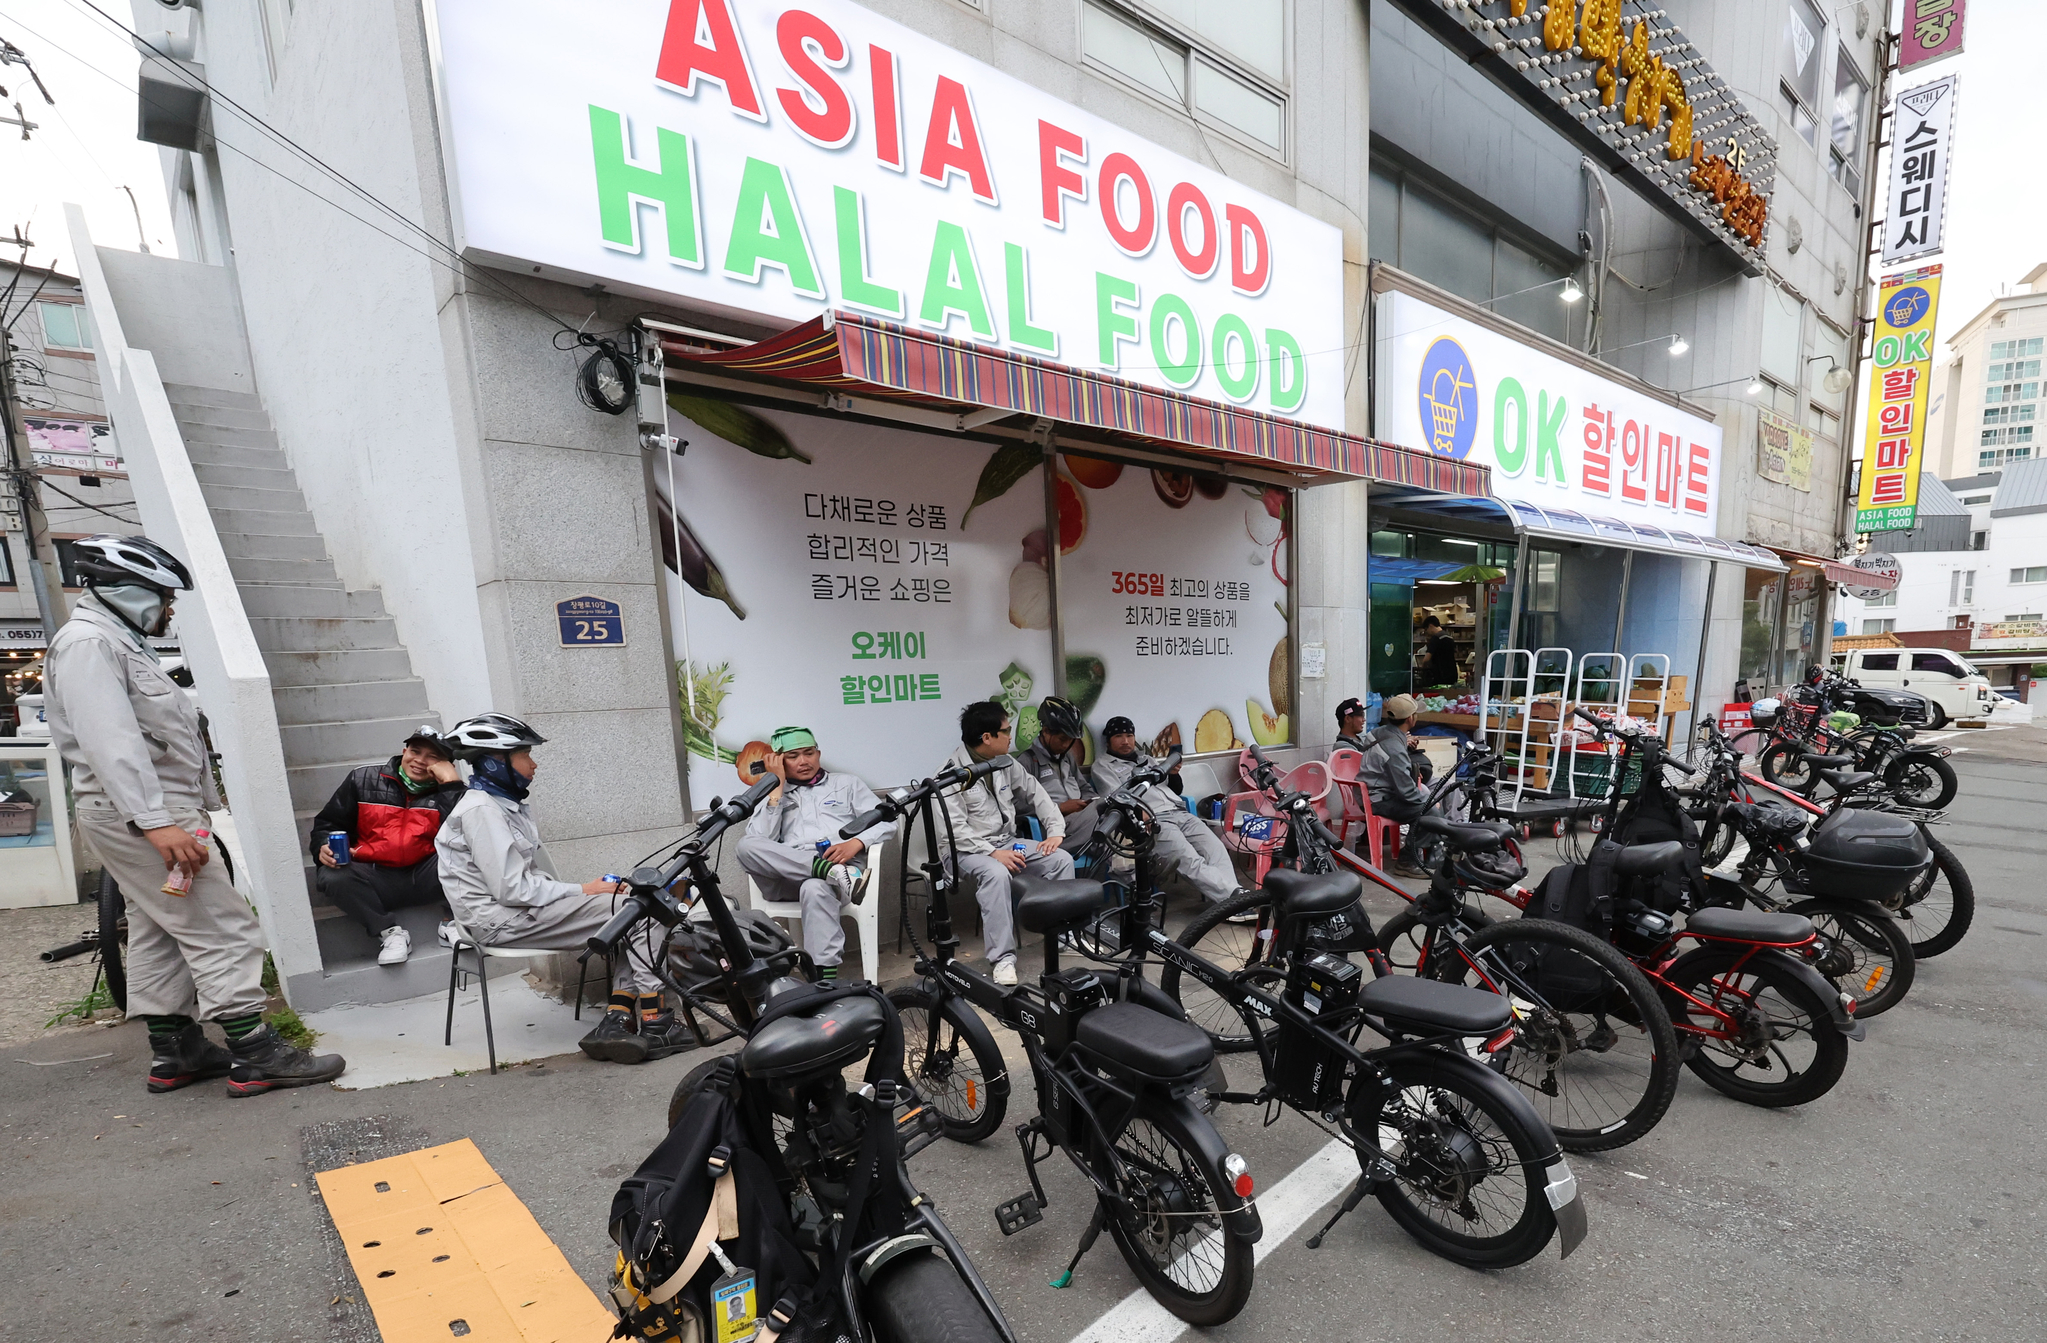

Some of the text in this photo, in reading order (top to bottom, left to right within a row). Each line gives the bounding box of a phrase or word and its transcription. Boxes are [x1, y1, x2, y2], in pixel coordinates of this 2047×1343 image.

[656, 0, 1269, 292] ASIA FOOD
[1726, 137, 1746, 172] 2F
[1895, 120, 1938, 250] 스웨디시
[588, 104, 1304, 409] HALAL FOOD
[1875, 331, 1928, 366] OK
[1494, 377, 1709, 513] OK 할인마트
[1872, 368, 1918, 503] 할인마트
[804, 492, 947, 530] 다채로운 상품
[1858, 517, 1911, 531] HALAL FOOD
[1859, 506, 1912, 521] ASIA FOOD
[807, 533, 949, 567] 합리적인 가격
[811, 573, 952, 603] 즐거운 쇼핑은
[1111, 571, 1250, 601] 365일 최고의 상품을
[575, 620, 609, 640] 25
[1125, 605, 1237, 628] 최저가로 알뜰하게
[851, 631, 926, 660] 오케이
[1135, 636, 1233, 656] 준비하겠습니다.
[840, 673, 942, 705] 할인마트
[1152, 941, 1200, 977] SCANIC
[944, 969, 971, 989] MOTOVELO
[1020, 1010, 1037, 1029] G8
[1243, 995, 1273, 1017] MAX
